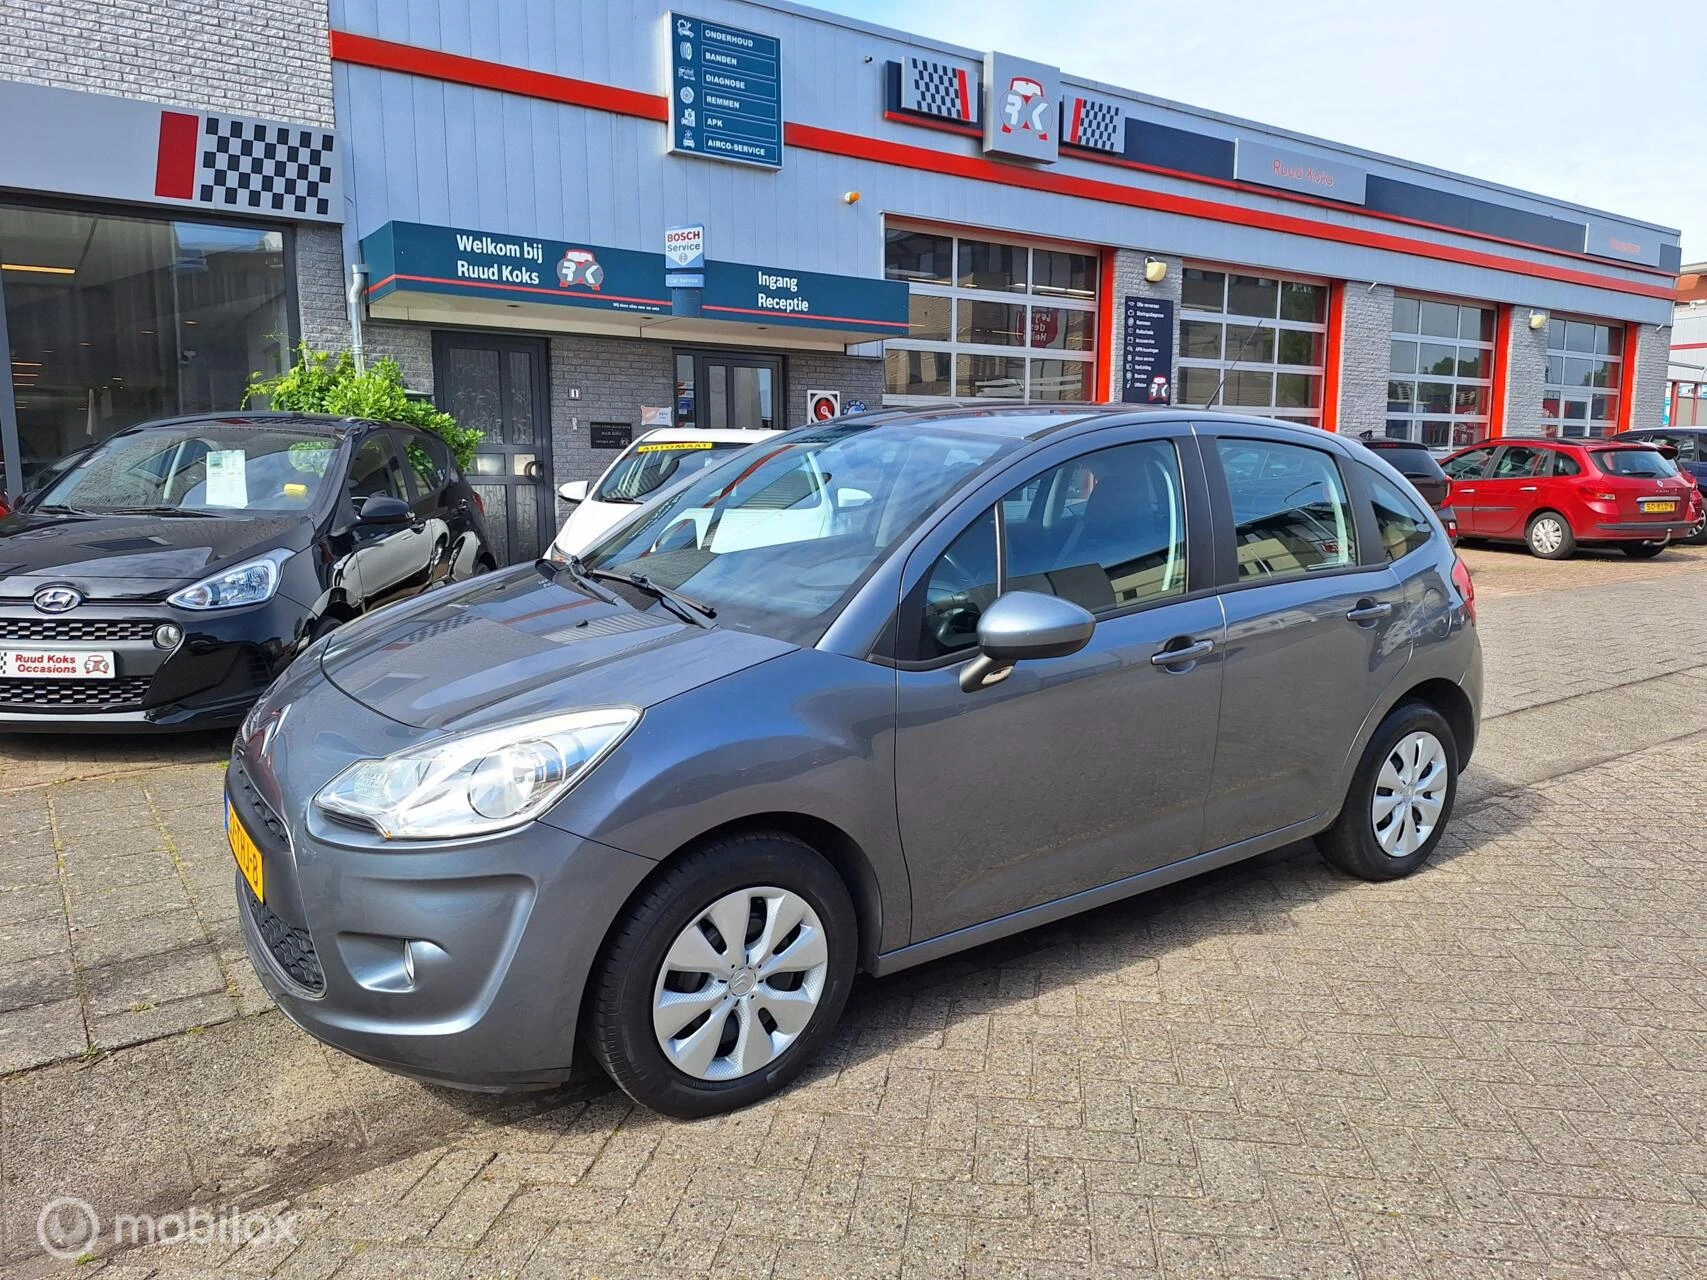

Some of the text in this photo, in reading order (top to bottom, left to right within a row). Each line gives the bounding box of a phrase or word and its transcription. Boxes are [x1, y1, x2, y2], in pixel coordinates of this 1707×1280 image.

[705, 30, 754, 48] ONDERHOUD
[706, 52, 737, 66] BANDEN
[706, 74, 746, 89] DIAGNOSE
[707, 96, 740, 109] REMMEN
[707, 117, 723, 128] APK
[708, 139, 766, 156] AIRCO-SERVICE
[1273, 159, 1303, 180] Ruud
[667, 230, 701, 243] BOSCH
[456, 234, 543, 264] Welkom bij
[667, 242, 701, 252] Service
[457, 260, 540, 285] Ruud Koks
[758, 271, 798, 292] Ingang
[758, 293, 809, 313] Receptie
[642, 444, 707, 452] AUTOMAAT
[15, 654, 76, 664] Ruud Koks
[17, 664, 77, 674] Occasions
